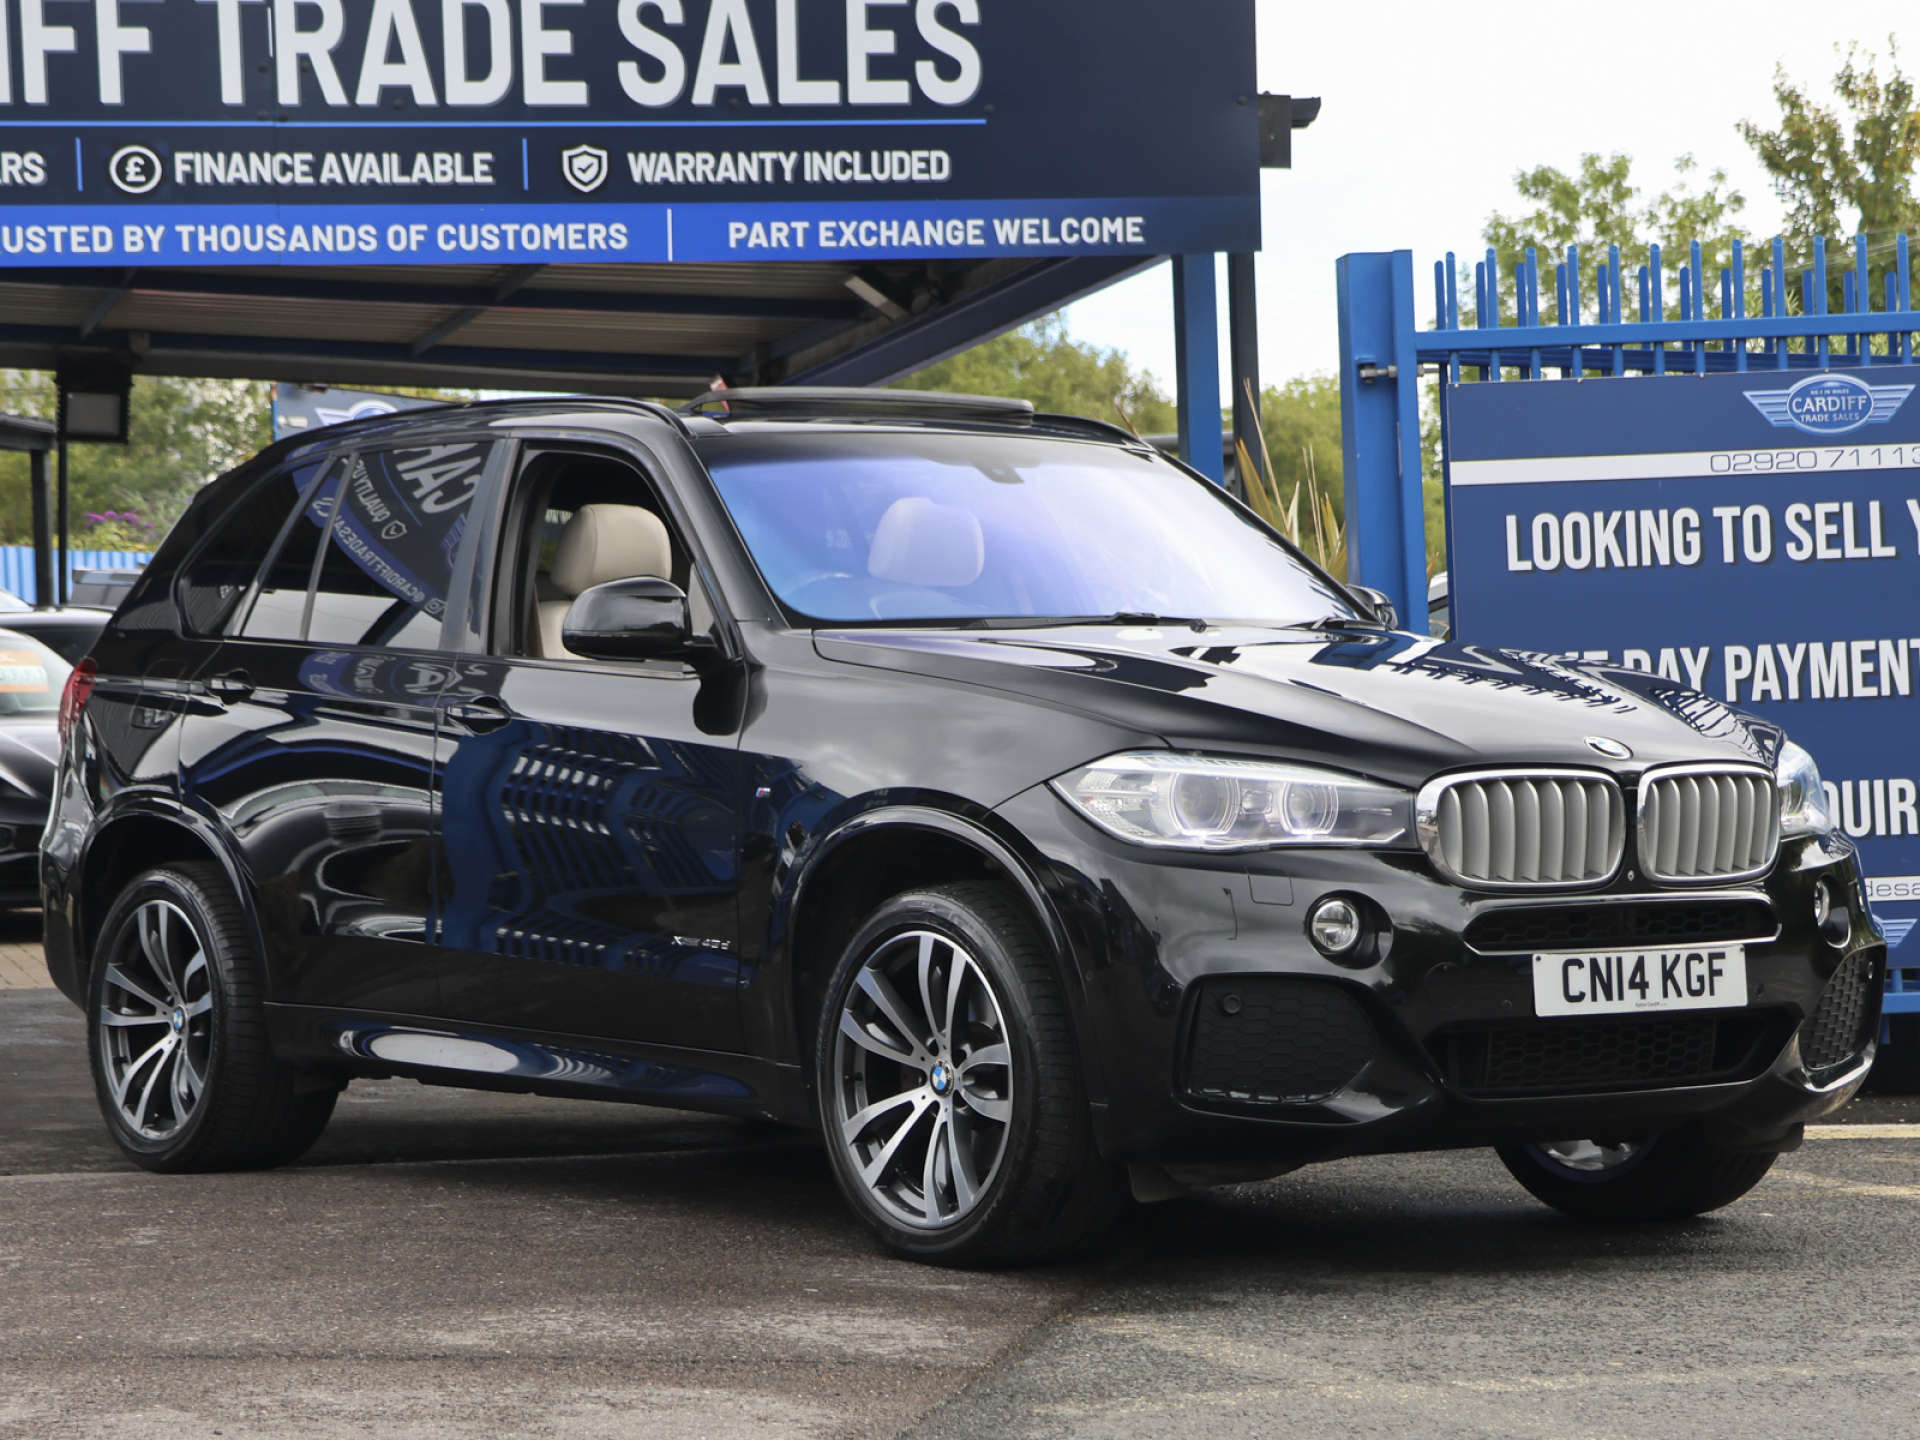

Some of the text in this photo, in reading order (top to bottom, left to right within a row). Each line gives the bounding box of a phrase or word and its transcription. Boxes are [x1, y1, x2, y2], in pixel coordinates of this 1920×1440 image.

[196, 0, 588, 106] TRADE
[618, 0, 981, 107] SALES
[0, 152, 45, 185] RS
[174, 152, 494, 185] FINANCE AVAILABLE
[627, 150, 950, 183] WARRANTY INCLUDED
[2, 223, 628, 253] USTED BY THOUSANDS OF CUSTOMERS
[729, 216, 1144, 248] PART EXCHANGE WELCOME
[1792, 394, 1867, 413] CARDIFF
[1800, 412, 1860, 424] TRADE SALES
[1710, 450, 1818, 472] 02920
[1506, 507, 1701, 571] LOOKING
[1713, 505, 1772, 563] TO
[1784, 500, 1896, 561] SELL
[1561, 951, 1726, 1003] CN14 KGF
